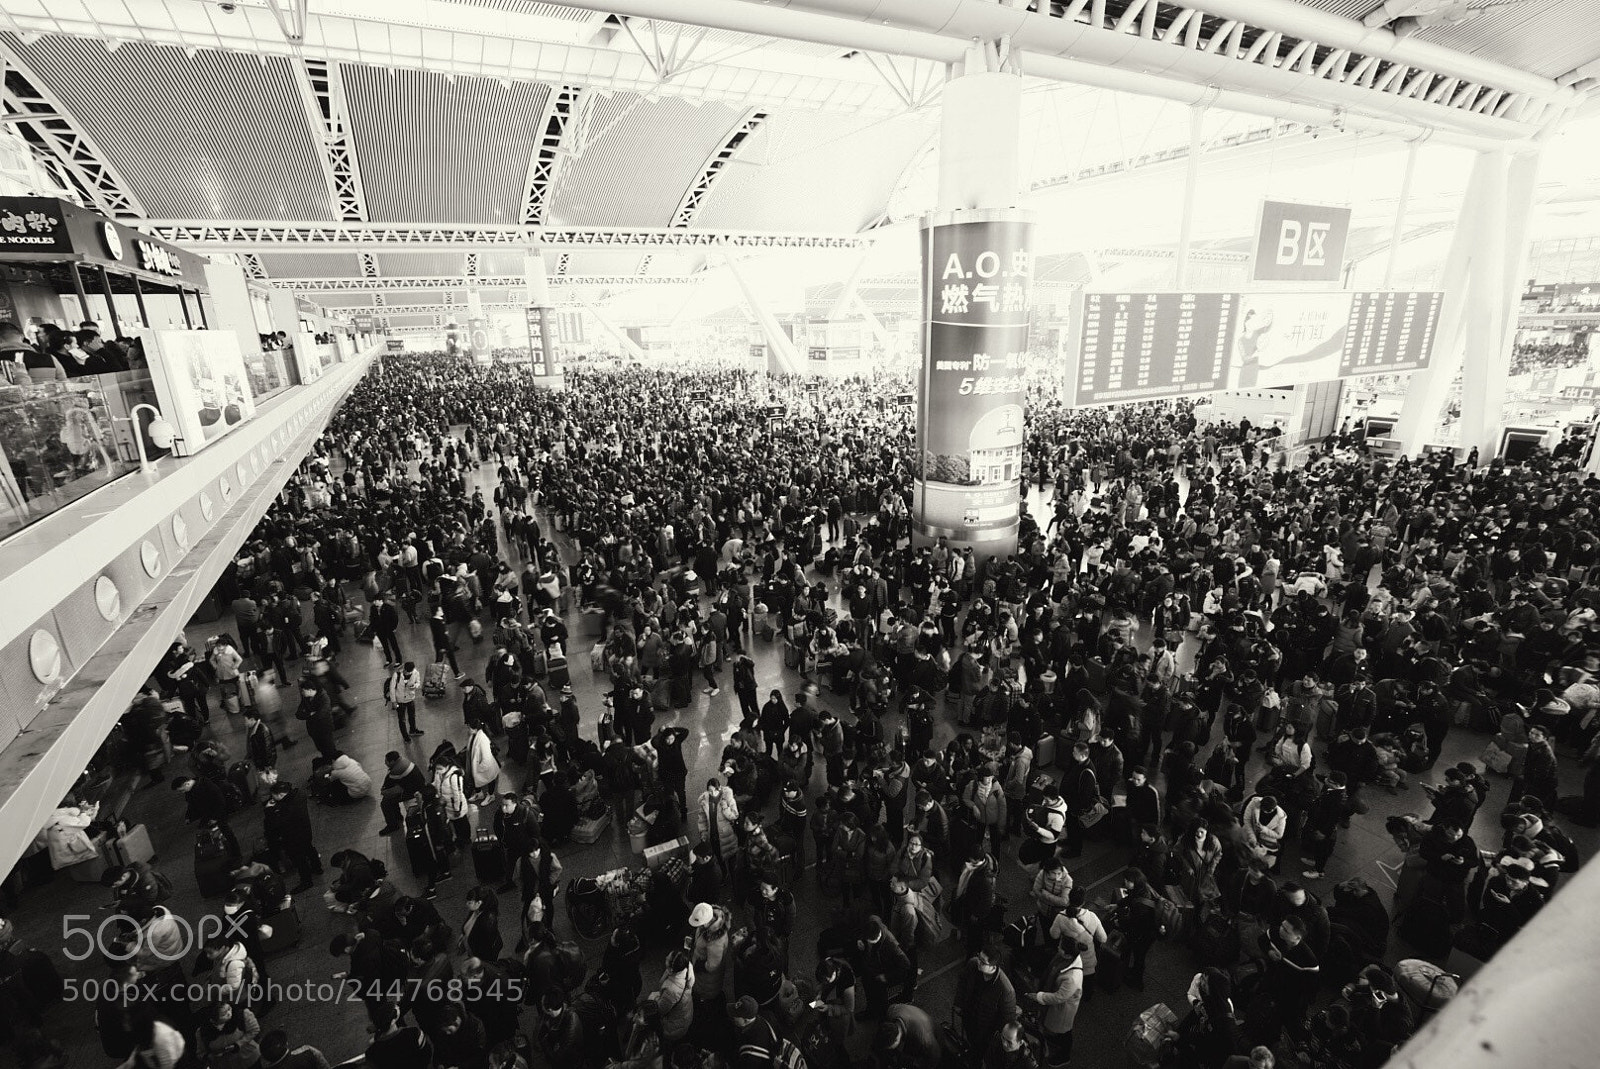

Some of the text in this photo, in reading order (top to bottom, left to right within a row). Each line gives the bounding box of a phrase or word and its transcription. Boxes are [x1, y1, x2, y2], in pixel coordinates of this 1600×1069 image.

[7, 236, 55, 244] NOODLES
[1275, 219, 1332, 266] B区
[1564, 387, 1594, 399] 出口
